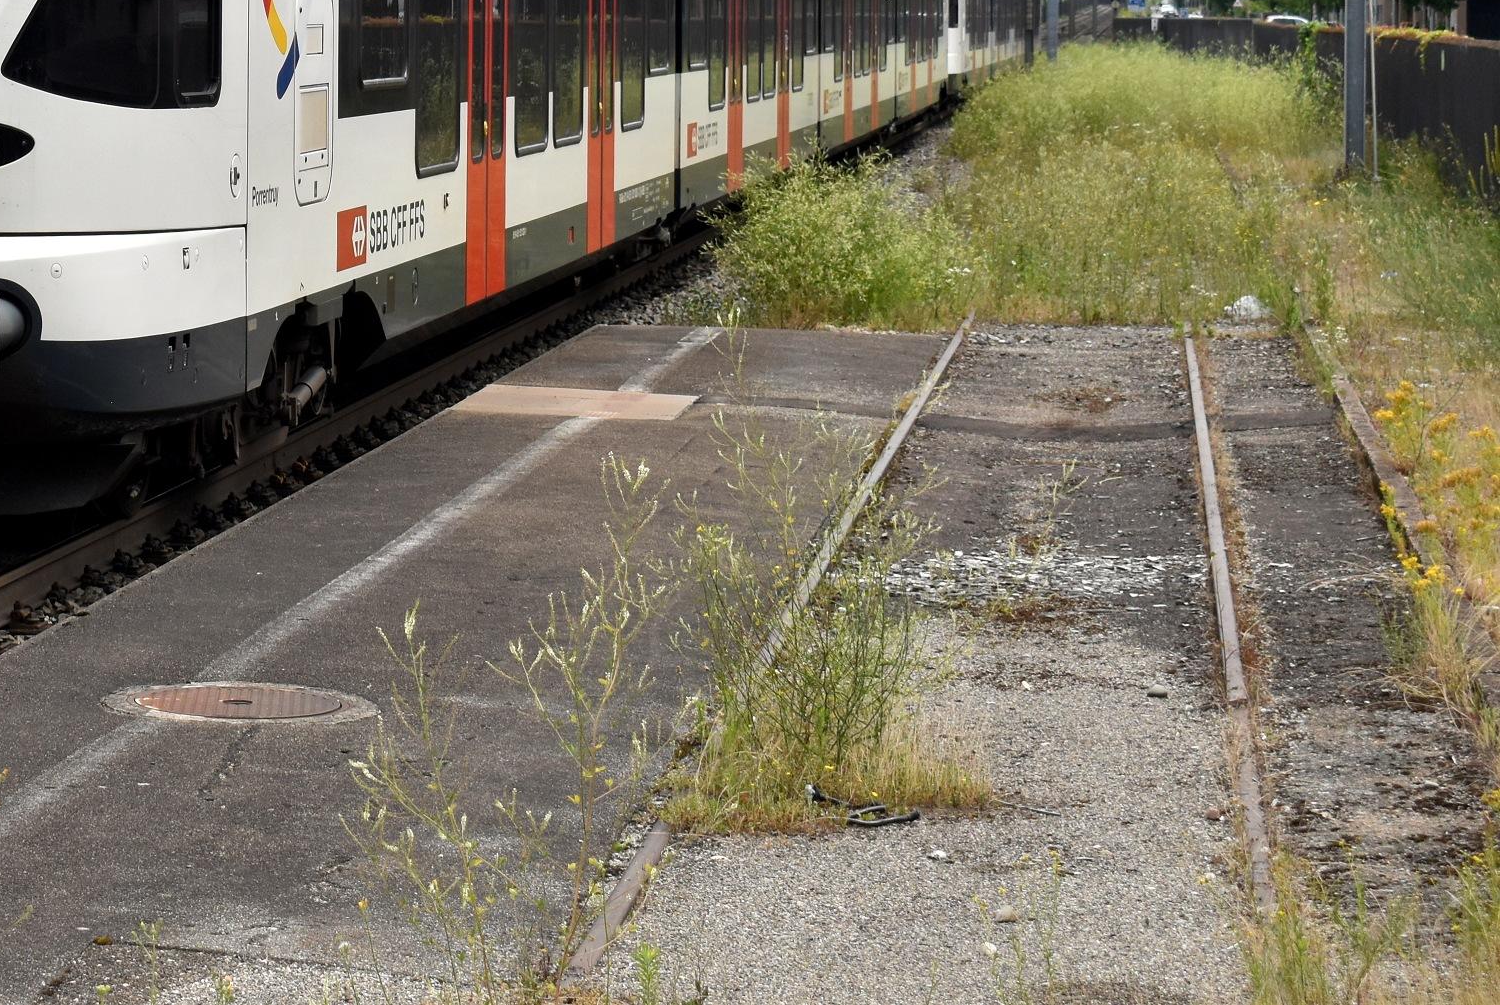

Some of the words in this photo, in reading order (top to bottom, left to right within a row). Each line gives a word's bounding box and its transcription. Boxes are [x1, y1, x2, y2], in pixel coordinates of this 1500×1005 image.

[251, 184, 280, 208] Porrentruy
[369, 211, 389, 255] SBB
[390, 206, 408, 249] CFF
[409, 198, 426, 239] FFS
